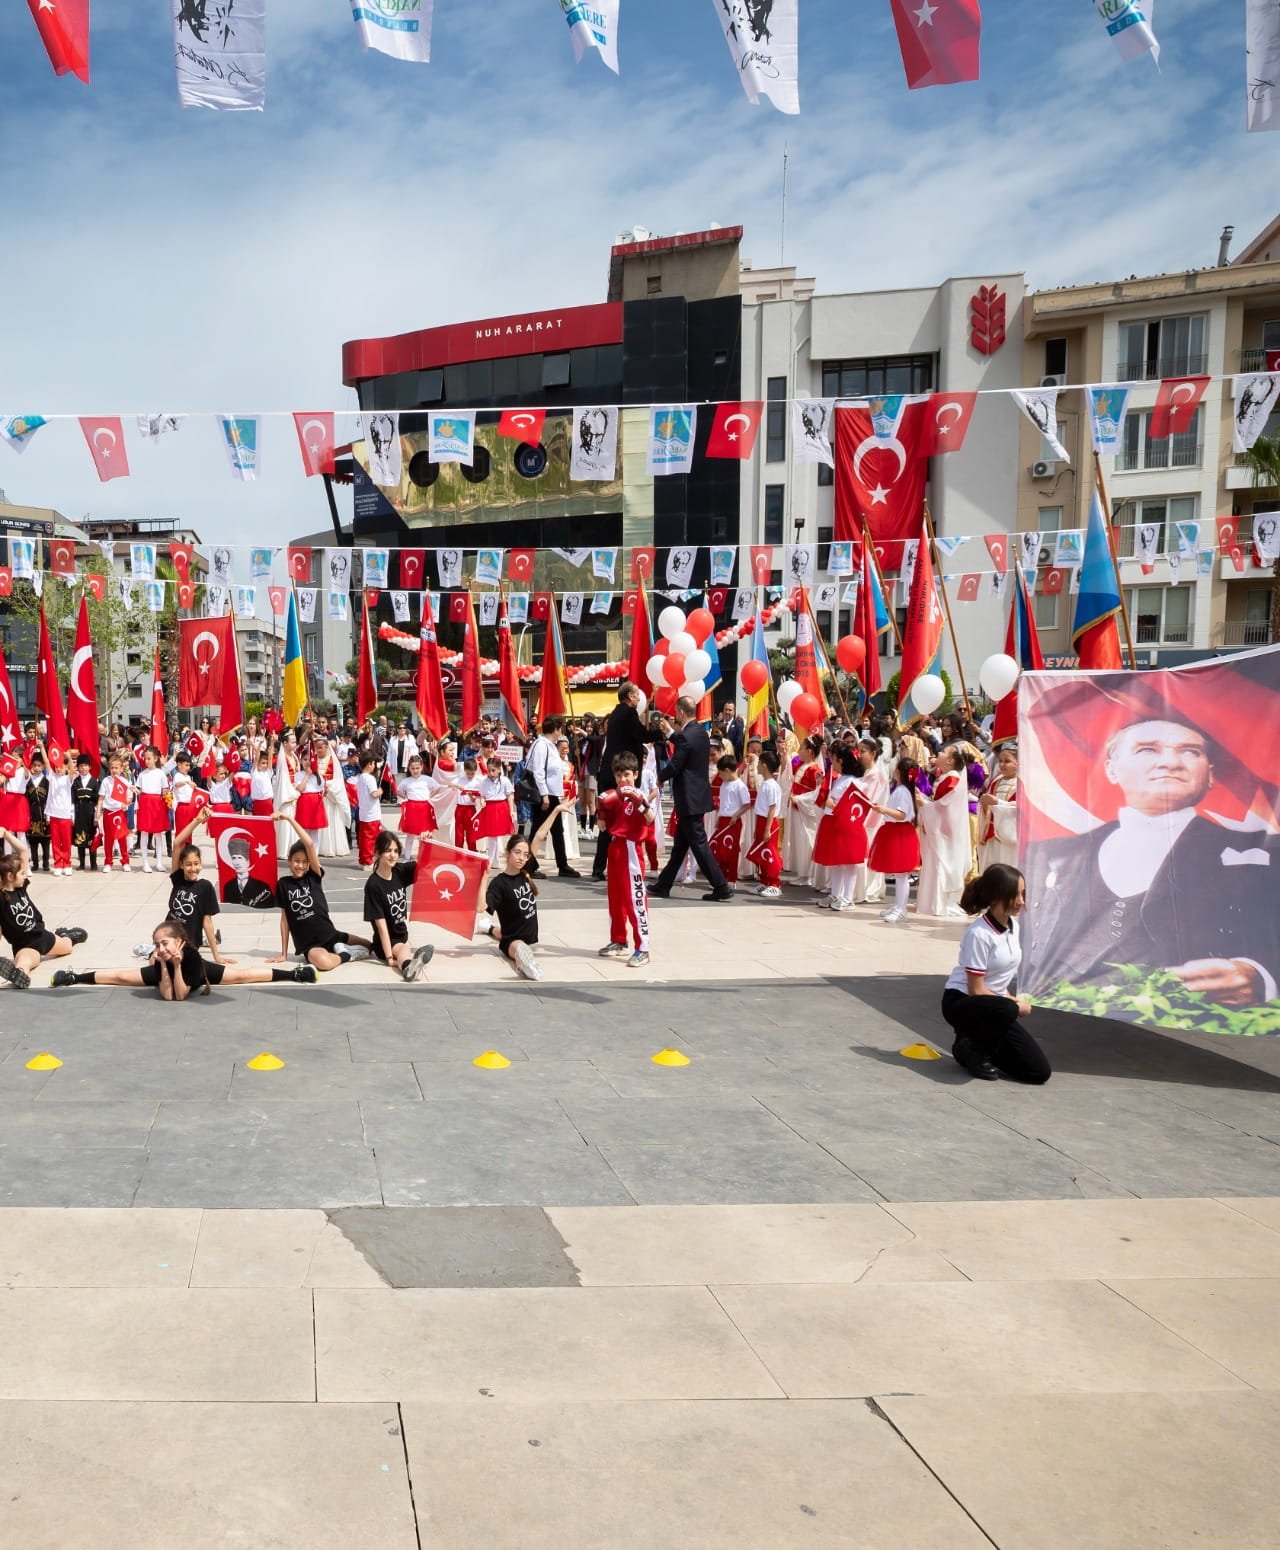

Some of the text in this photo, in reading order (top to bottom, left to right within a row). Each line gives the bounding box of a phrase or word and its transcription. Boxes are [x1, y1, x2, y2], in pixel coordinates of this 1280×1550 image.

[476, 319, 562, 339] NUH ARARAT
[633, 874, 649, 936] KICK BOKS
